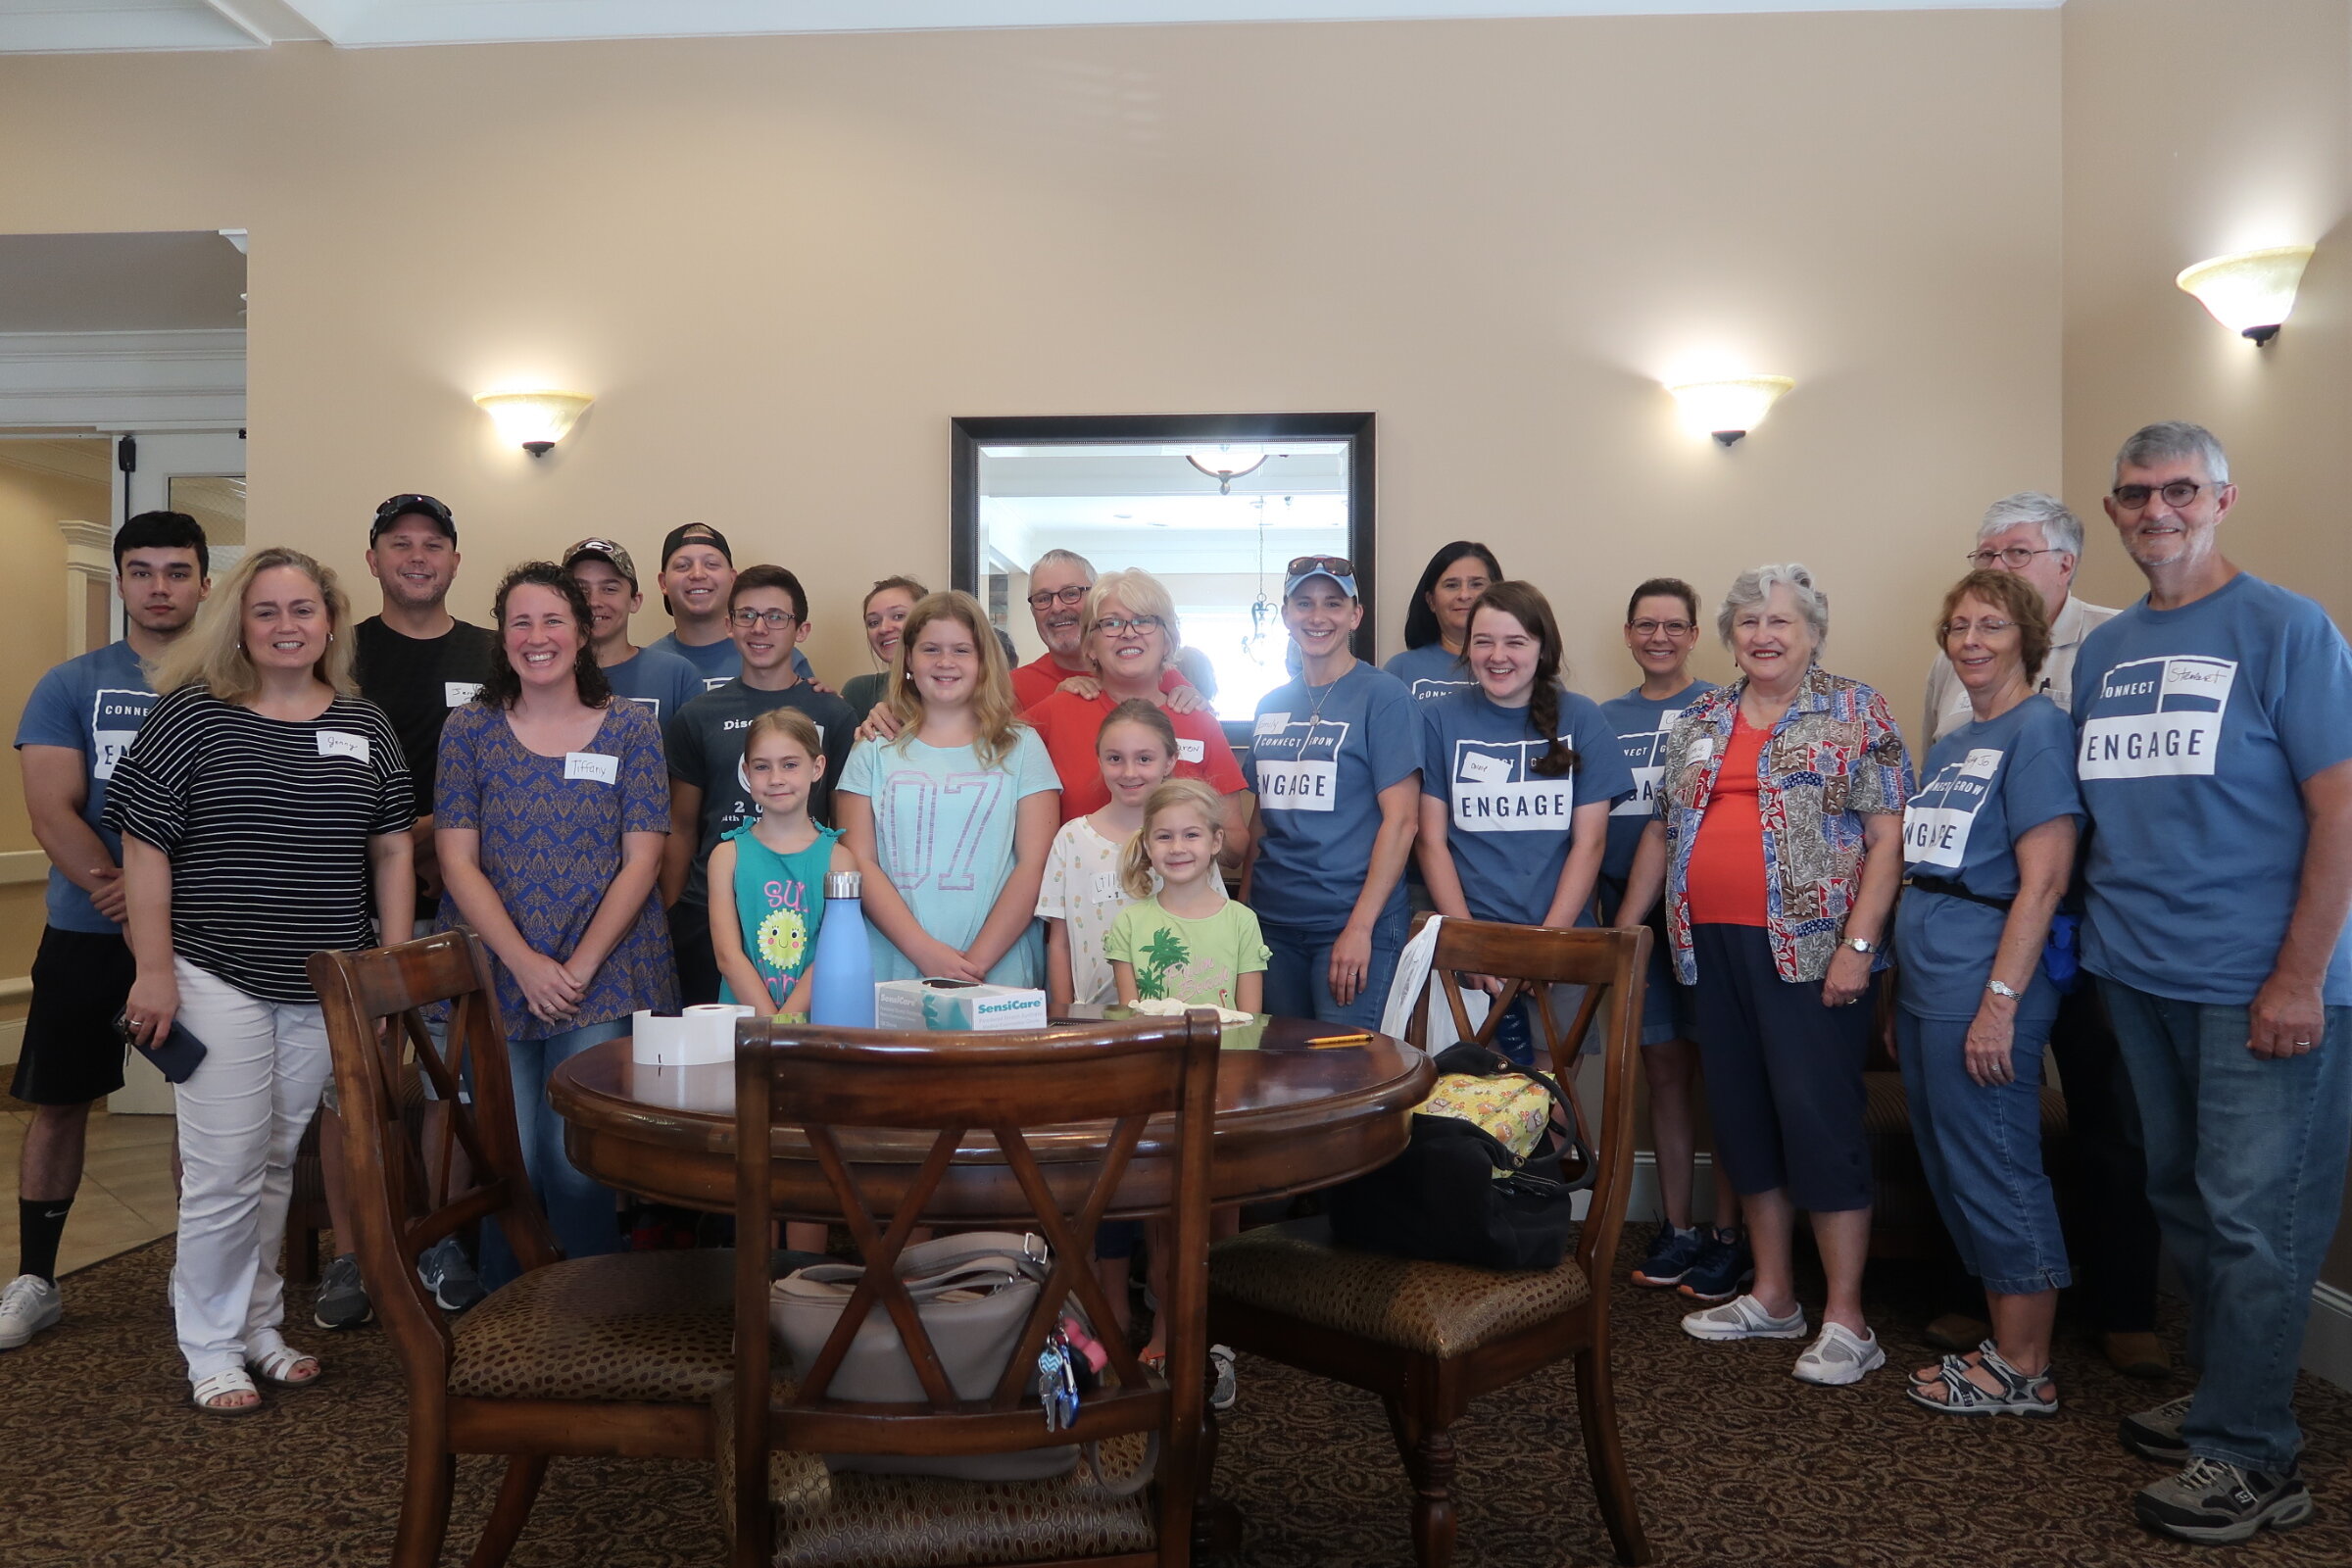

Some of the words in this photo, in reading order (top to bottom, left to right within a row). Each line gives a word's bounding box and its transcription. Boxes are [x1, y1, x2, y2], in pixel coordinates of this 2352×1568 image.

[1418, 690, 1452, 701] CONN
[1260, 737, 1302, 748] CONNECT
[2086, 729, 2205, 761] ENGAGE
[570, 760, 607, 778] Tiffany
[1256, 773, 1326, 797] NGAGE
[1953, 780, 1984, 796] GROW
[1461, 794, 1564, 817] ENGAGE
[978, 999, 1042, 1014] SensiCare
